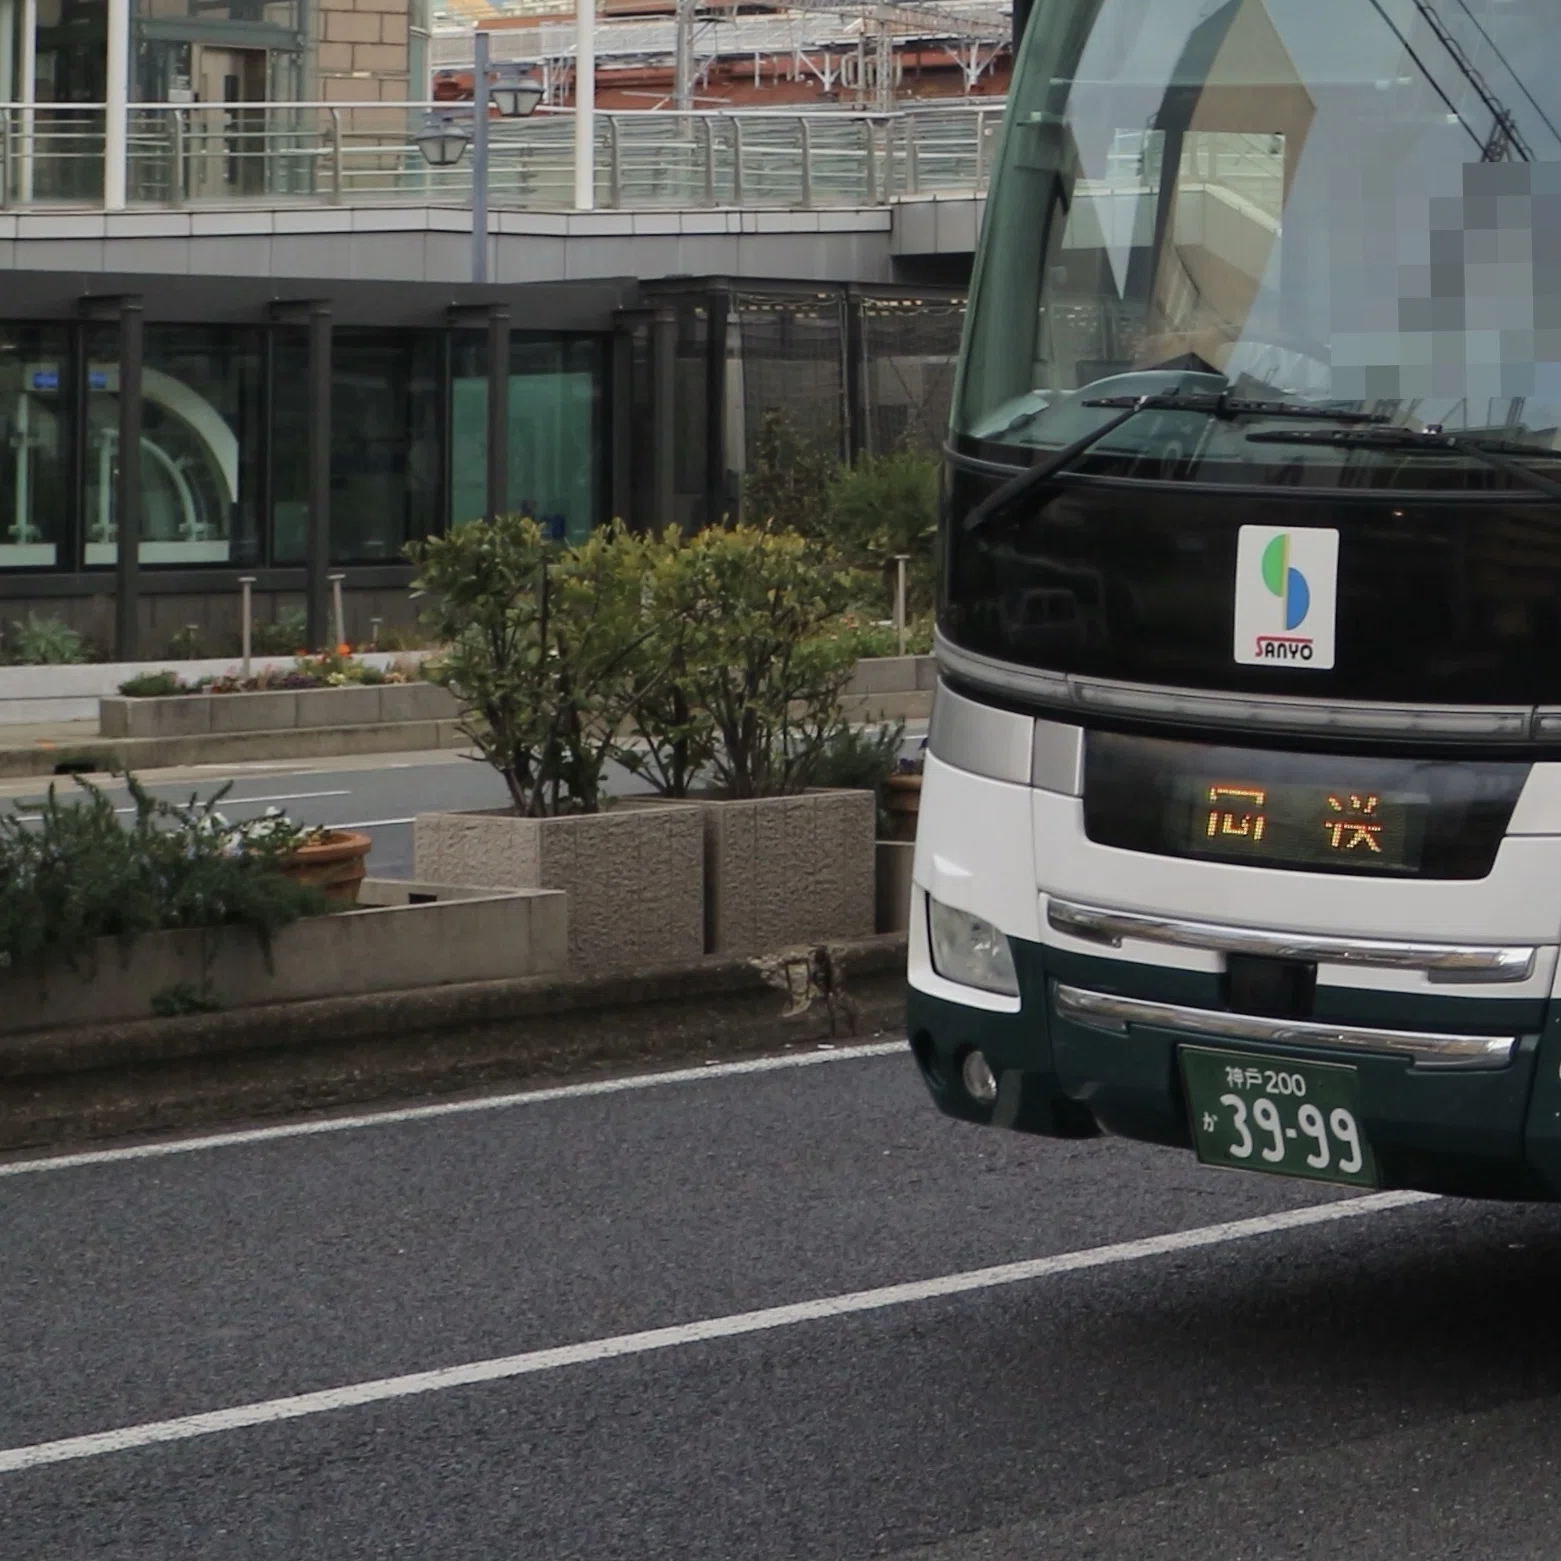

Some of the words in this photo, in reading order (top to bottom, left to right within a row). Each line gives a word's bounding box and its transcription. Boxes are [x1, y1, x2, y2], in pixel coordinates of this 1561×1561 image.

[1255, 636, 1313, 661] SANYO
[1203, 1111, 1218, 1132] か
[1220, 1094, 1363, 1173] 39-99
